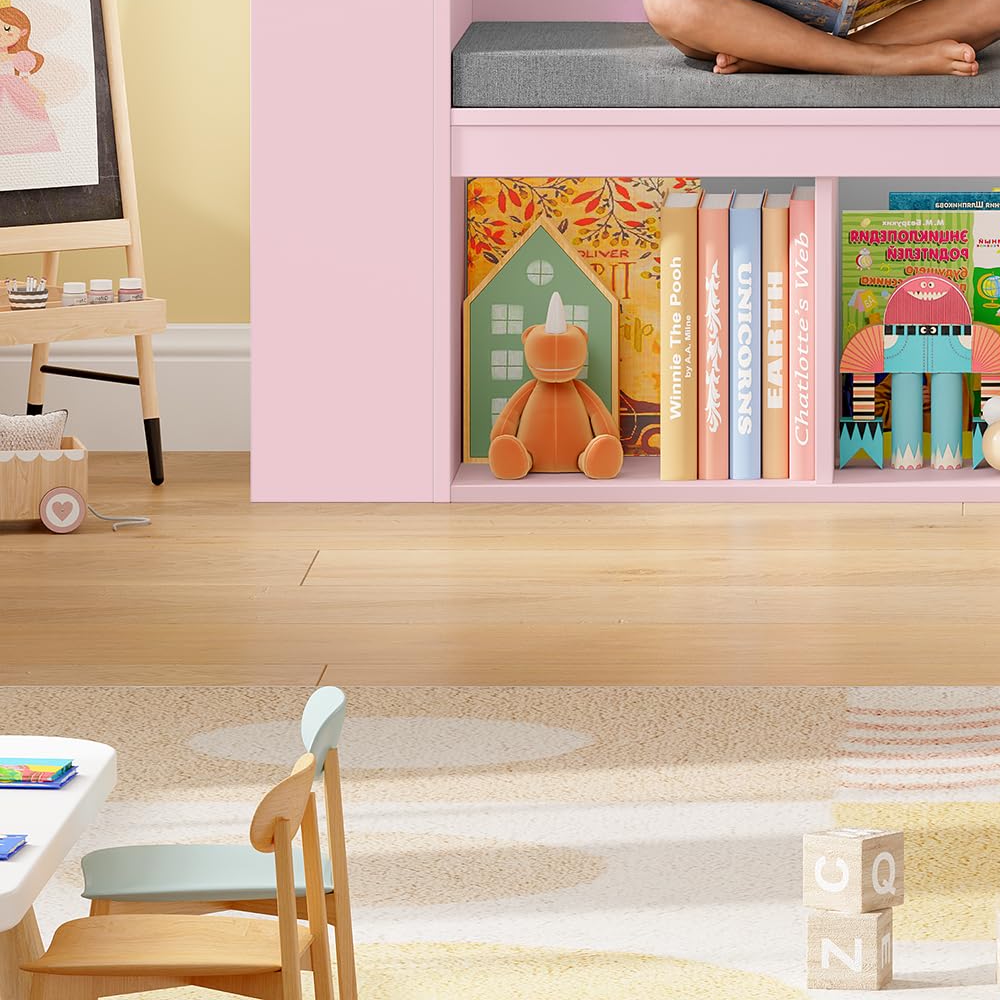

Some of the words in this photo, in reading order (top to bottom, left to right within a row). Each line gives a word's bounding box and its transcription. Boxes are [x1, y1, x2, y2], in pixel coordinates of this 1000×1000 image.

[669, 256, 682, 306] Pooh
[794, 232, 809, 289] Web
[669, 312, 682, 348] The
[684, 314, 692, 341] Milne
[737, 261, 752, 435] UNICORNS
[767, 271, 783, 409] EARTH
[684, 343, 692, 364] A.A.
[684, 365, 693, 378] by
[669, 353, 682, 421] Winnie
[871, 851, 896, 896] Q
